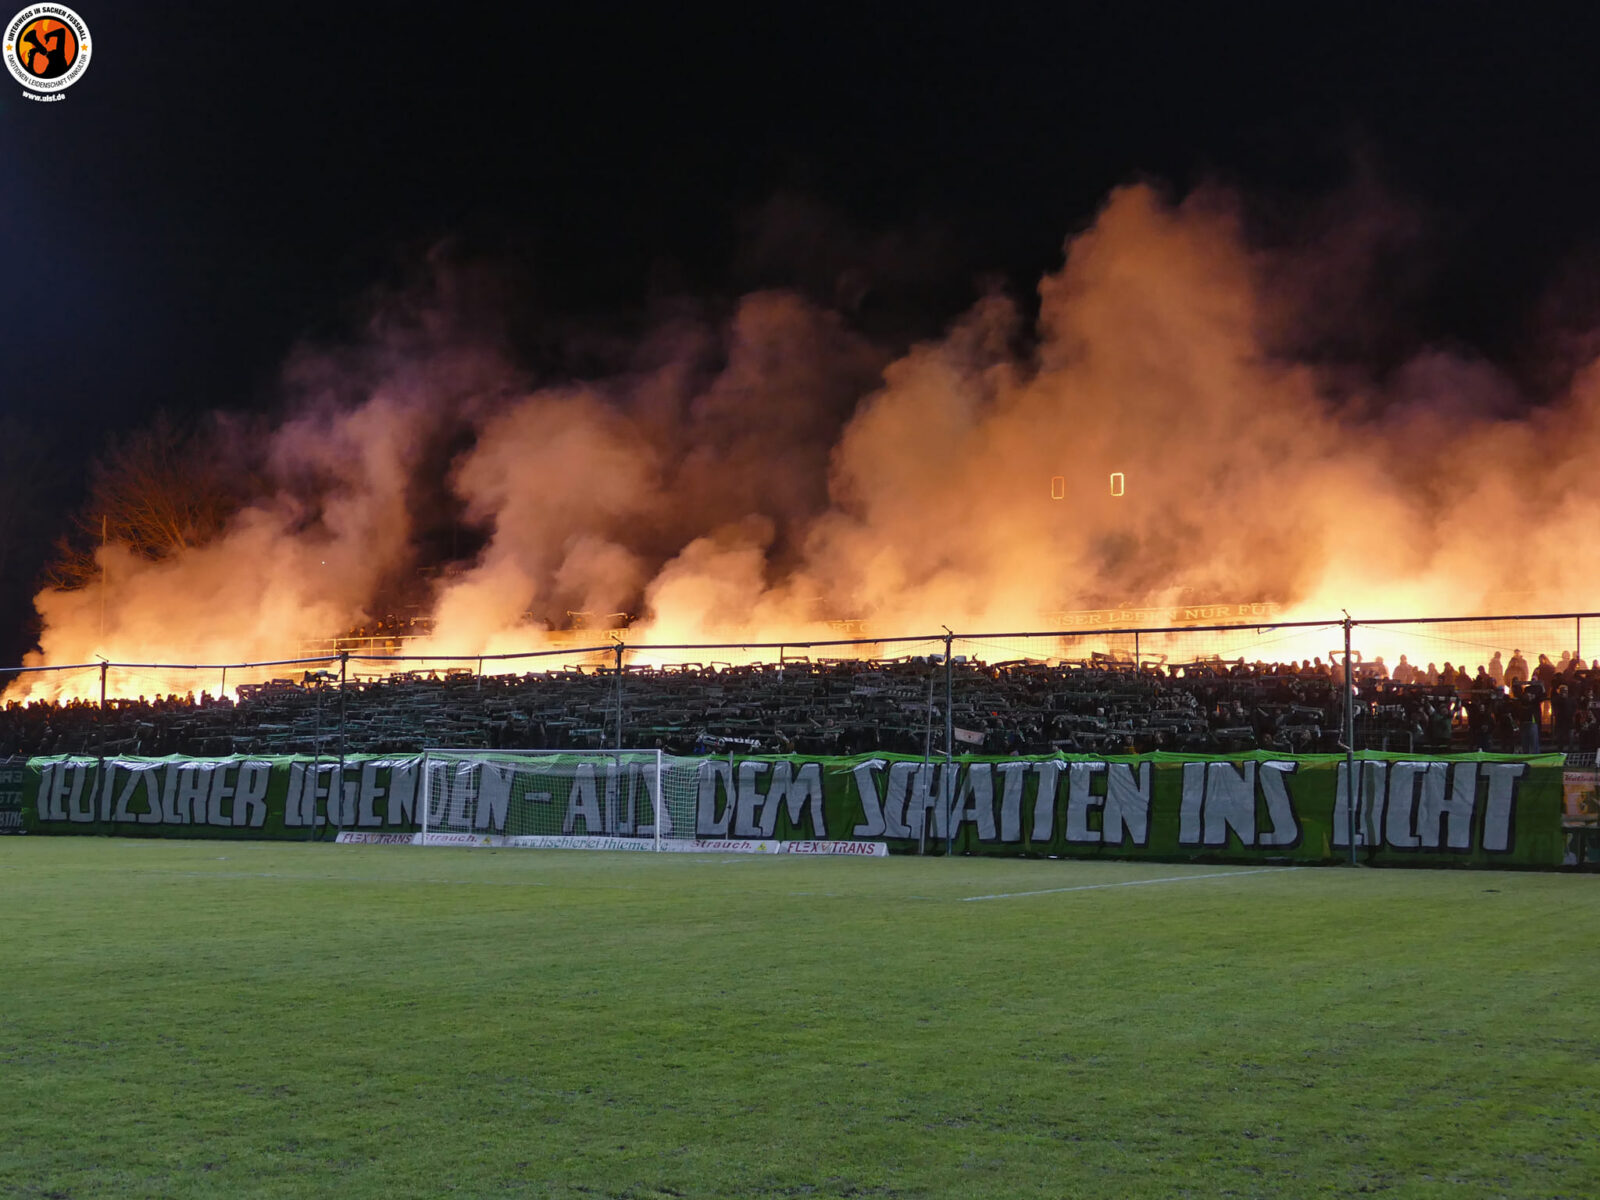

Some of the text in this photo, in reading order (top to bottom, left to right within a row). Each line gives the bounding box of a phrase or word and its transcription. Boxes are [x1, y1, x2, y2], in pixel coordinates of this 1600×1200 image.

[1184, 606, 1231, 620] NUR
[285, 760, 514, 830] LEGENDEN
[562, 762, 674, 834] AUS
[695, 759, 827, 837] DEM
[853, 758, 1151, 844] SCHATTEN
[1178, 760, 1300, 847] INS
[1332, 759, 1530, 852] LICHT
[342, 833, 413, 844] FLEX TRANS
[788, 841, 876, 855] FLEX TRANS
